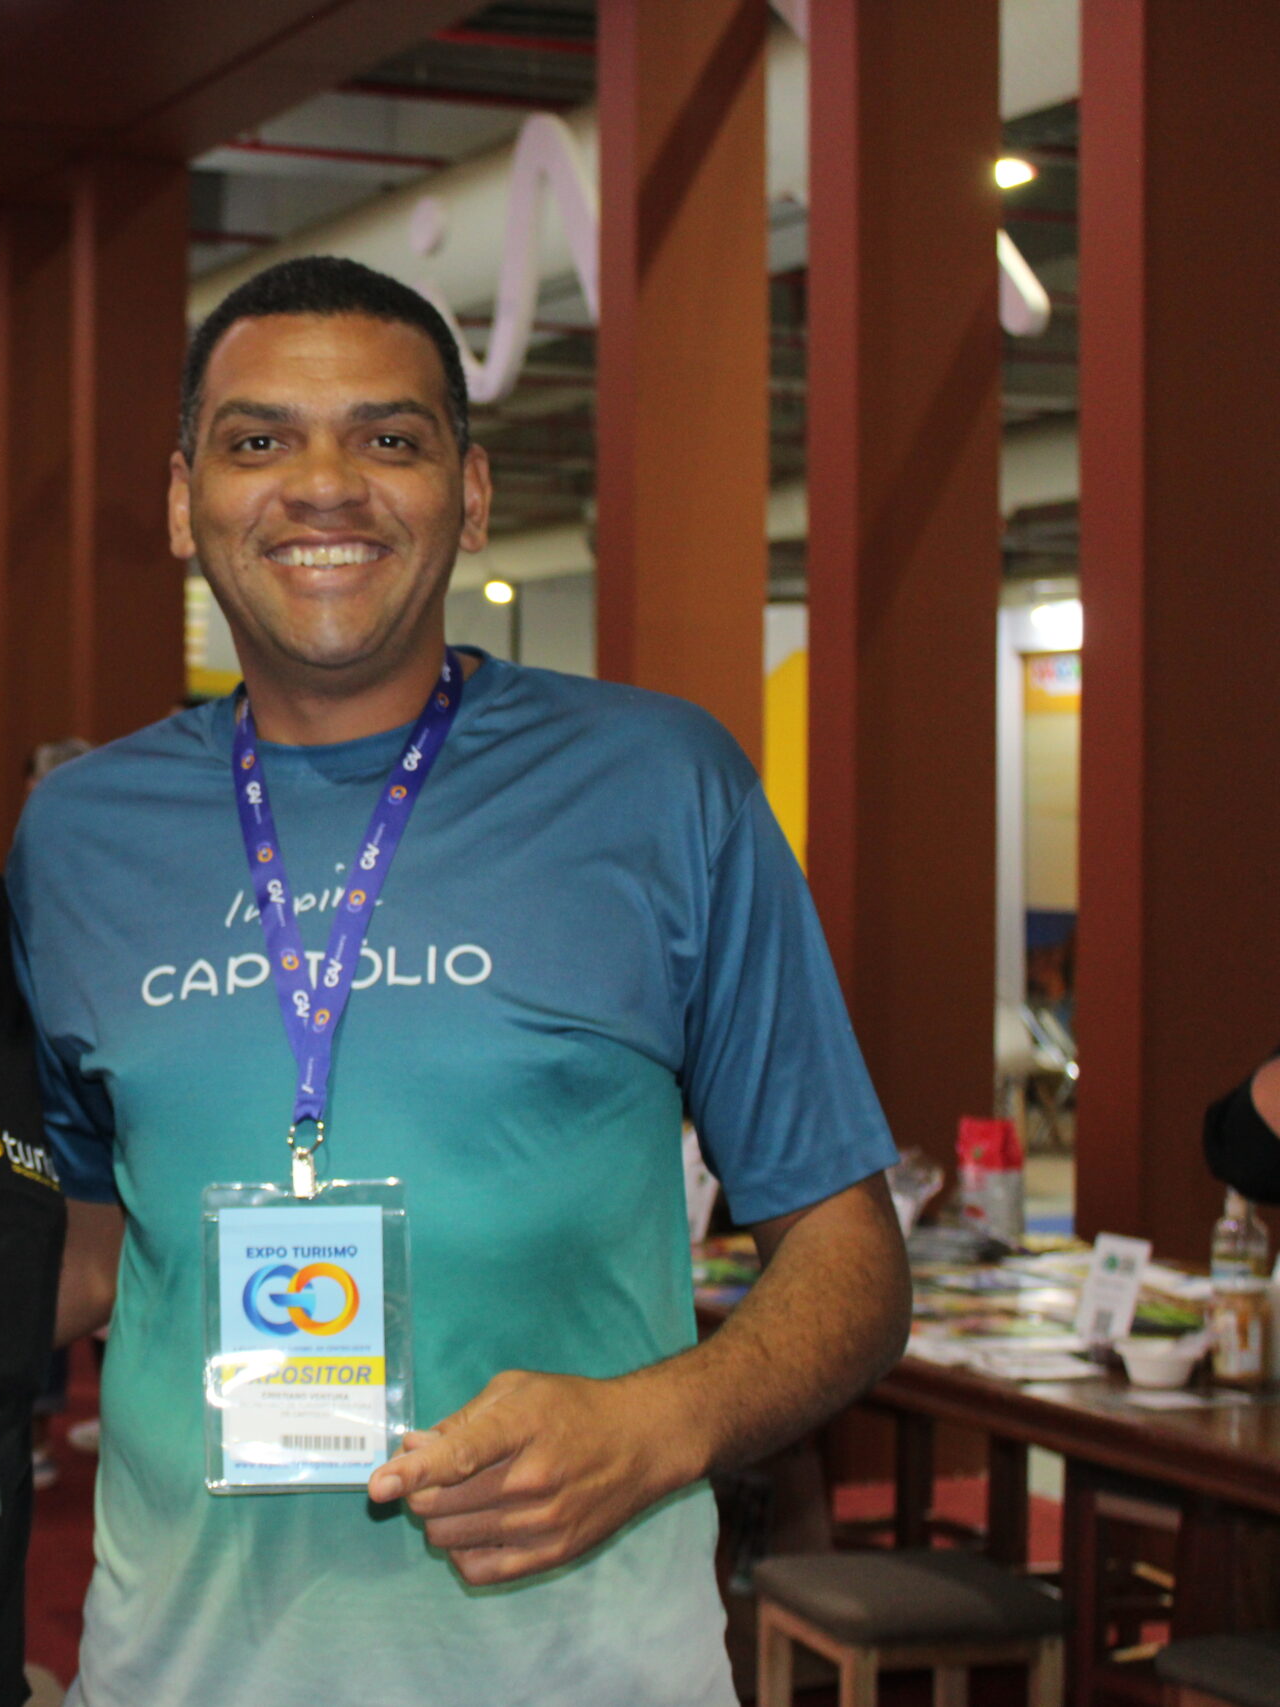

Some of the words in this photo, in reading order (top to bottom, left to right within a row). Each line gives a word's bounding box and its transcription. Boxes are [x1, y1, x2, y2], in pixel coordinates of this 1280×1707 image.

[141, 938, 492, 1007] CAPTÓLIO
[245, 1247, 287, 1259] EXPO
[292, 1245, 357, 1259] TURISMO
[242, 1262, 359, 1337] GO
[233, 1365, 372, 1384] POSITOR
